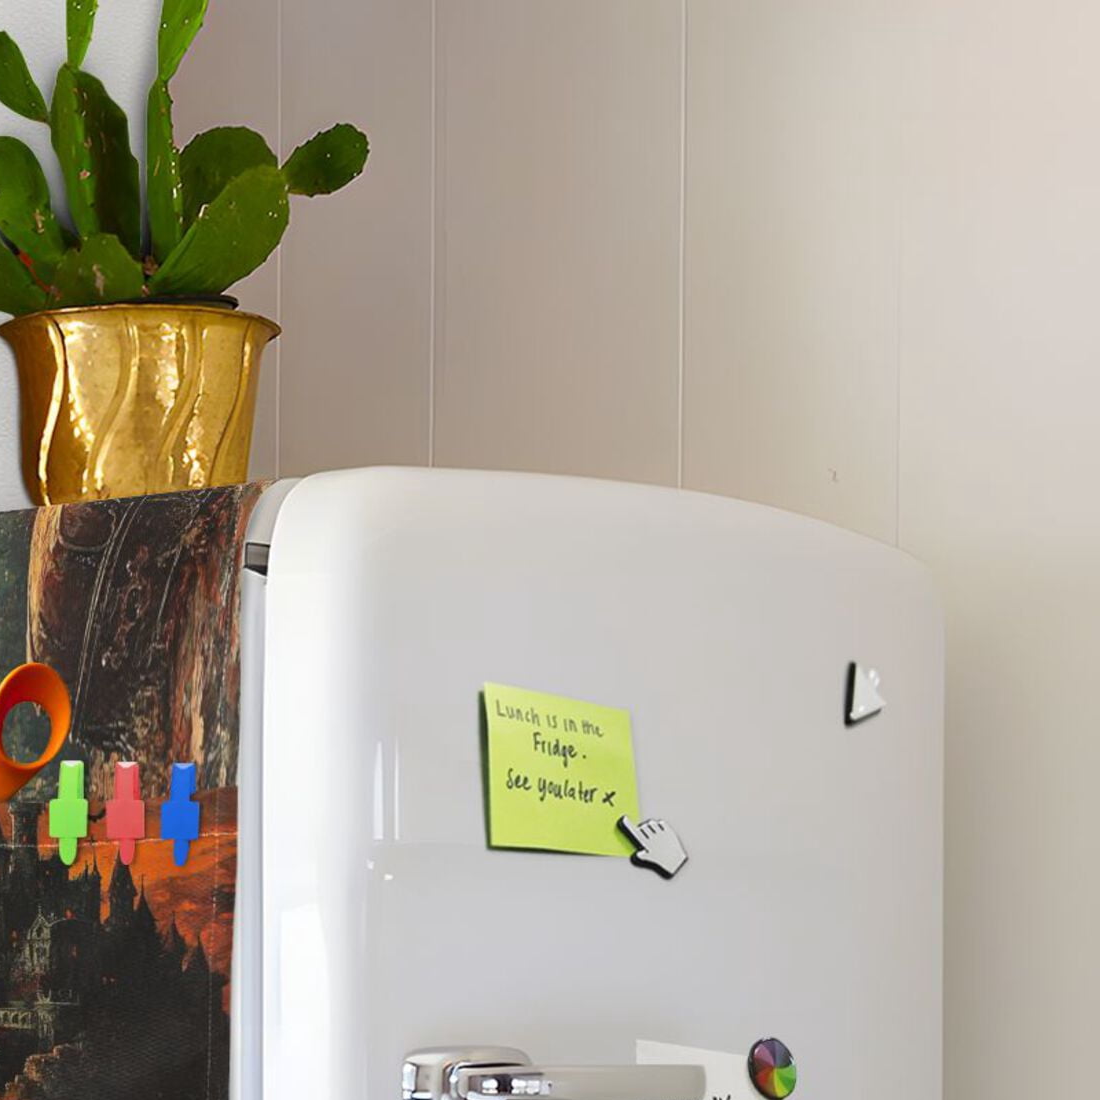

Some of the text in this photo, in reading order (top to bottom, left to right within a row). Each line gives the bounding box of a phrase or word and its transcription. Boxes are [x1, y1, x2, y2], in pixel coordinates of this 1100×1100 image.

[496, 699, 604, 738] Lunch is in the
[506, 768, 532, 791] See
